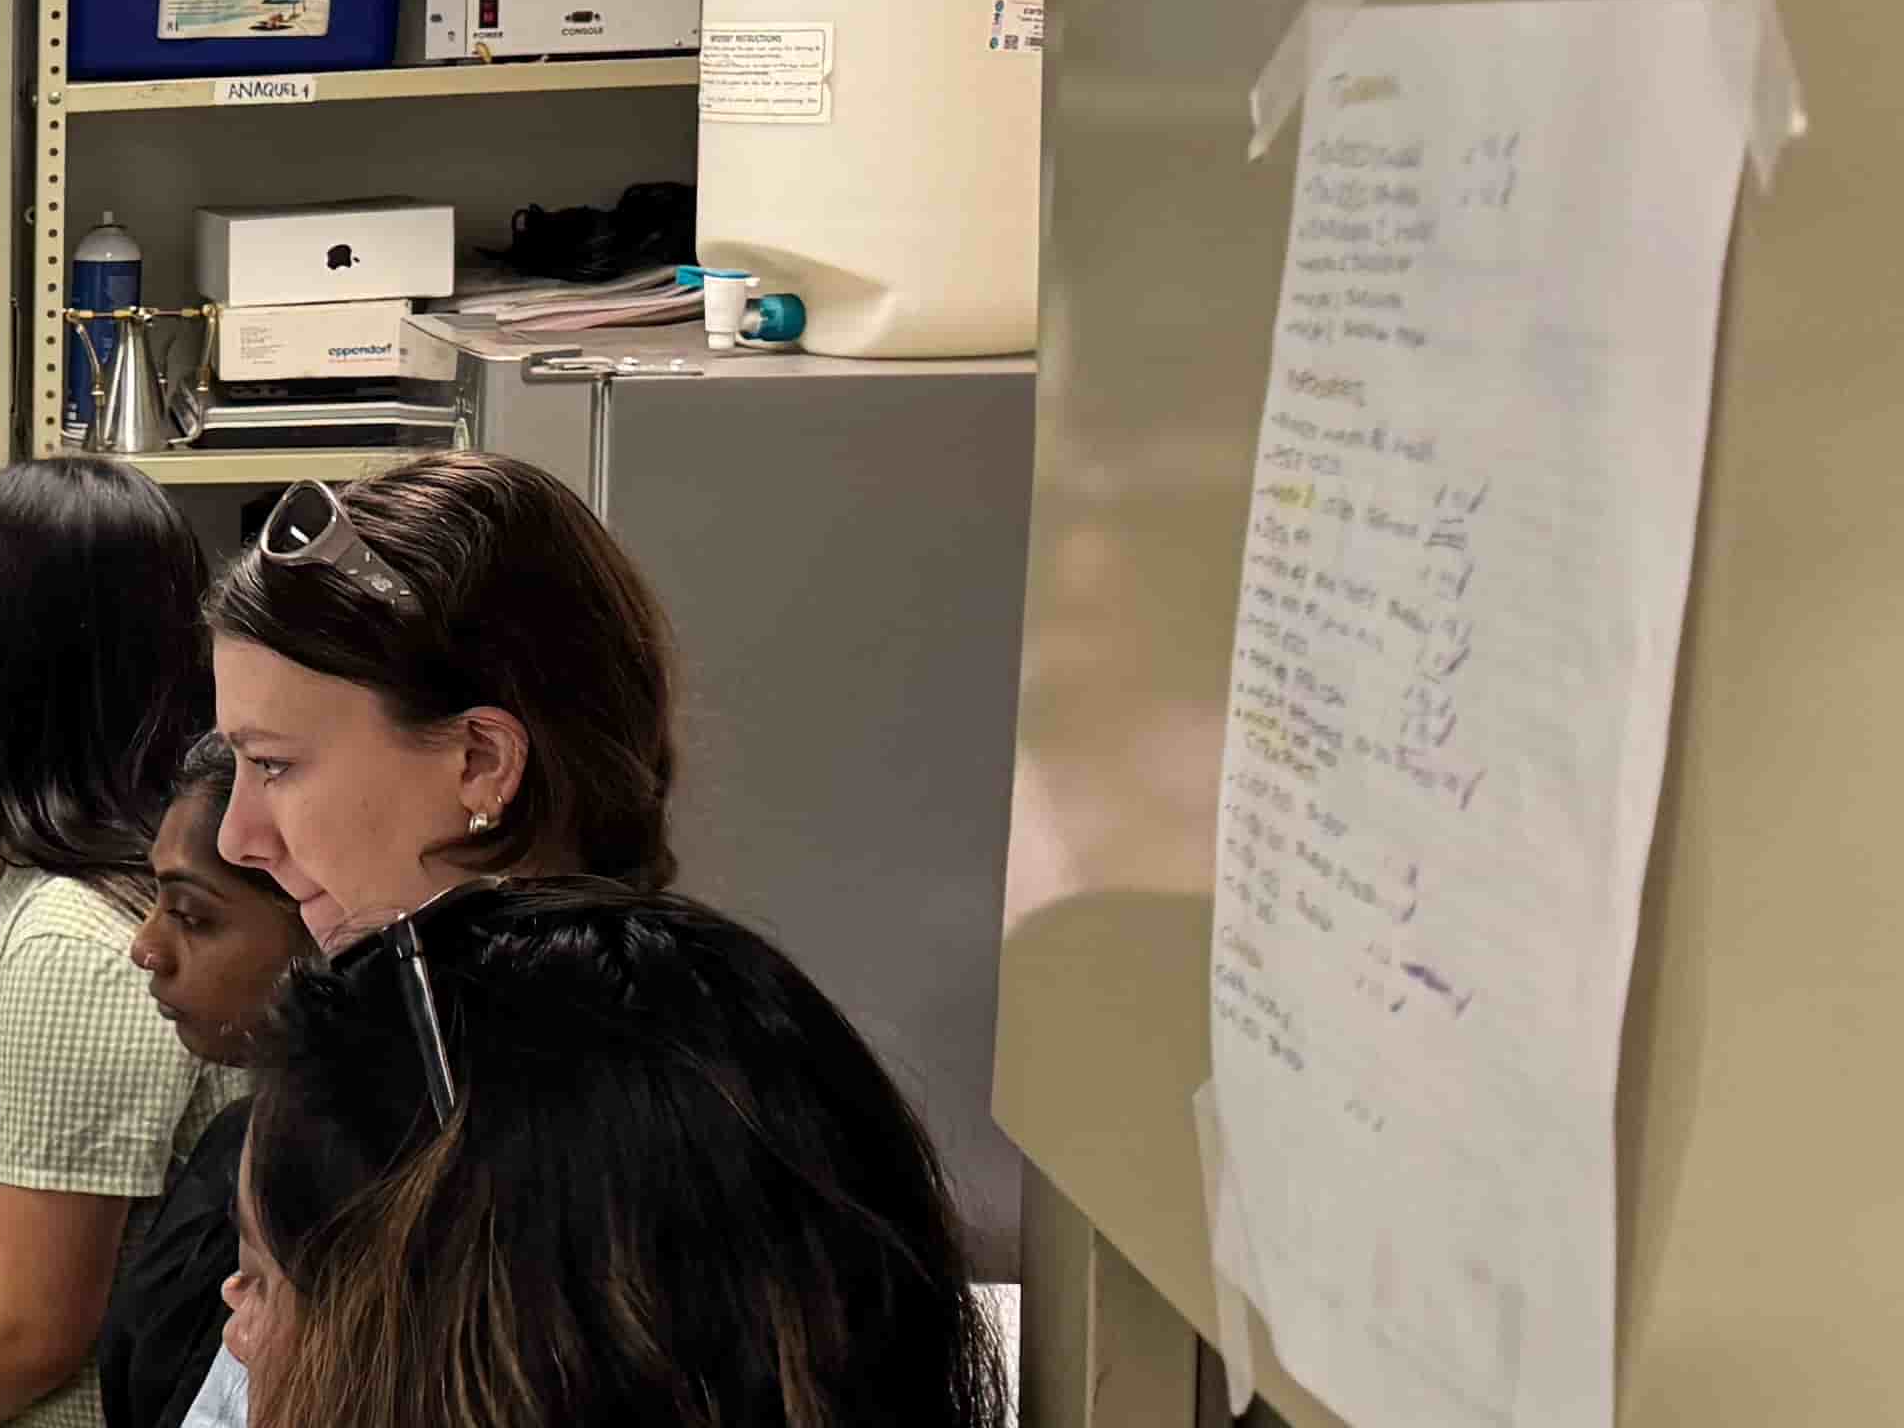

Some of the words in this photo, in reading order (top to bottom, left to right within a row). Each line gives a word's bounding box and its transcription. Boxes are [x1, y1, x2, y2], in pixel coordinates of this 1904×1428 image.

[472, 30, 504, 39] POWER
[561, 26, 604, 36] CONSOLE
[228, 81, 299, 100] ANAQUEL
[327, 343, 392, 357] eppendorf
